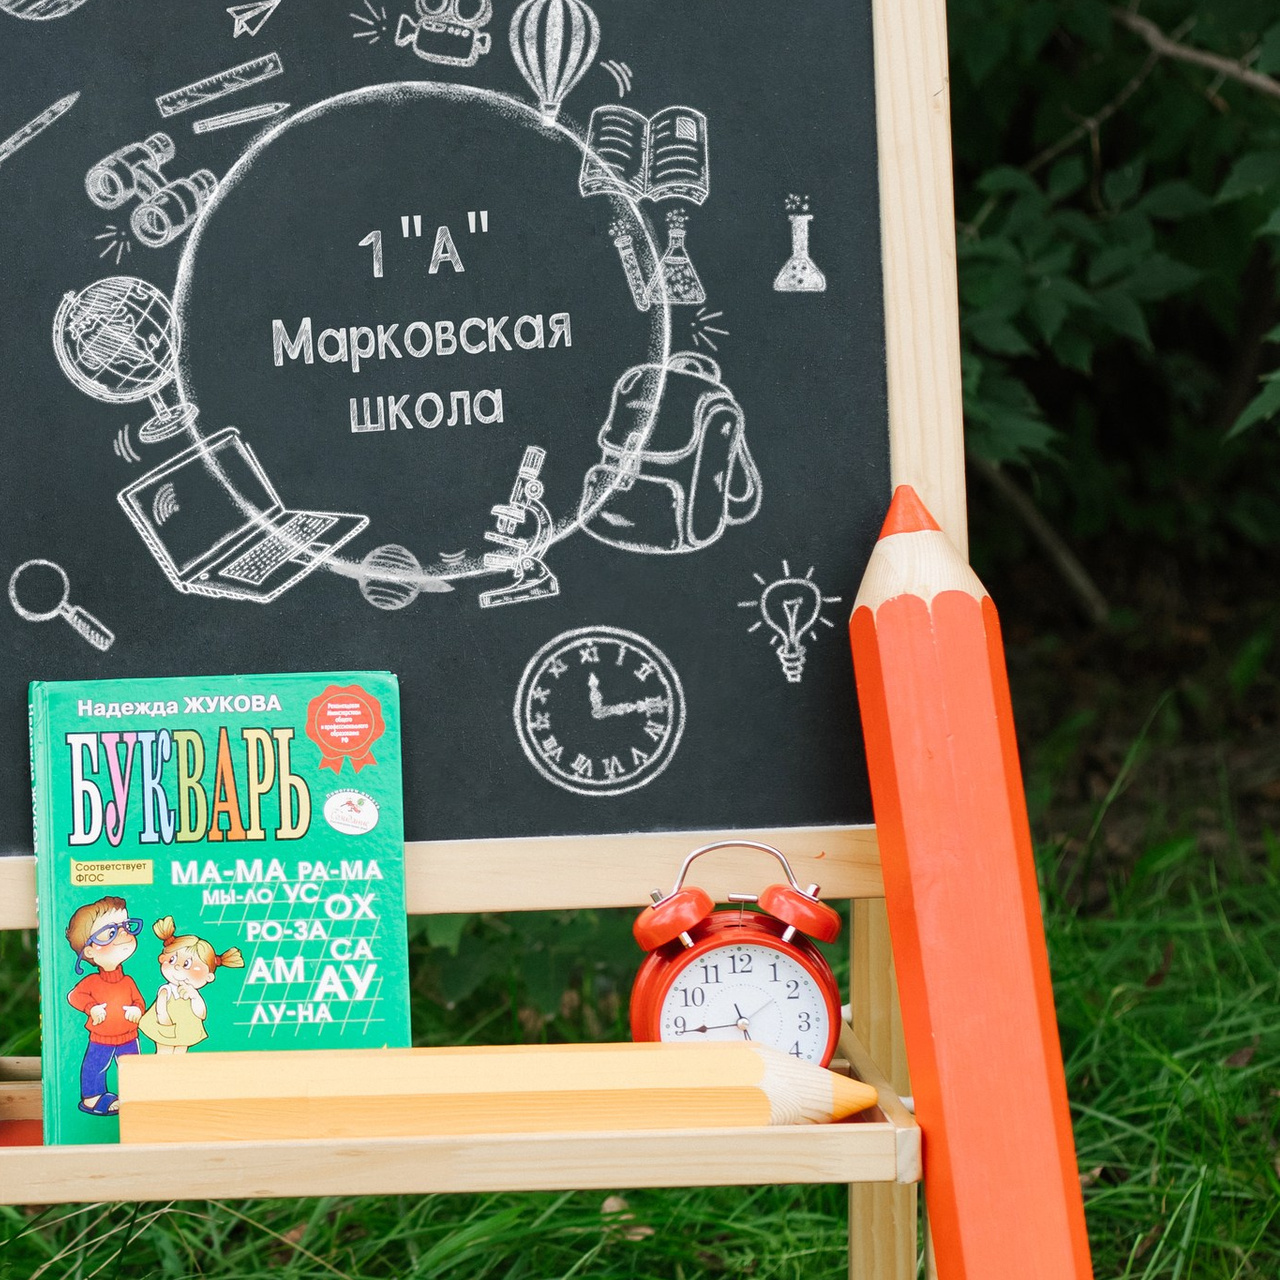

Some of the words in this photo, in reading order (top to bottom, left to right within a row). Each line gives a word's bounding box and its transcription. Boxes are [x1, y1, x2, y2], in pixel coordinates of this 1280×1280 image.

[272, 312, 572, 373] Марковская
[349, 388, 504, 433] школа
[78, 699, 179, 718] Надежда
[183, 694, 282, 714] ЖУКОВА
[65, 726, 312, 848] БУКВАРЬ
[75, 862, 147, 873] Соответствует
[75, 873, 105, 883] ФГОС
[171, 858, 286, 885] МА-МА
[298, 860, 384, 881] РА-МА
[202, 888, 272, 905] МЫ-ЛО
[283, 883, 319, 904] УС
[324, 893, 376, 920] ОХ
[247, 921, 327, 942] РО-ЗА
[330, 939, 374, 960] СА
[248, 956, 304, 984] АМ
[700, 964, 723, 985] 11
[727, 953, 753, 975] 12
[769, 963, 782, 983] 1
[313, 964, 377, 1001] АУ
[786, 980, 800, 1000] 2
[680, 986, 706, 1008] 10
[251, 1003, 333, 1024] ЛУ-НА
[798, 1011, 811, 1032] 3
[674, 1016, 687, 1037] 9
[788, 1040, 803, 1060] 4
